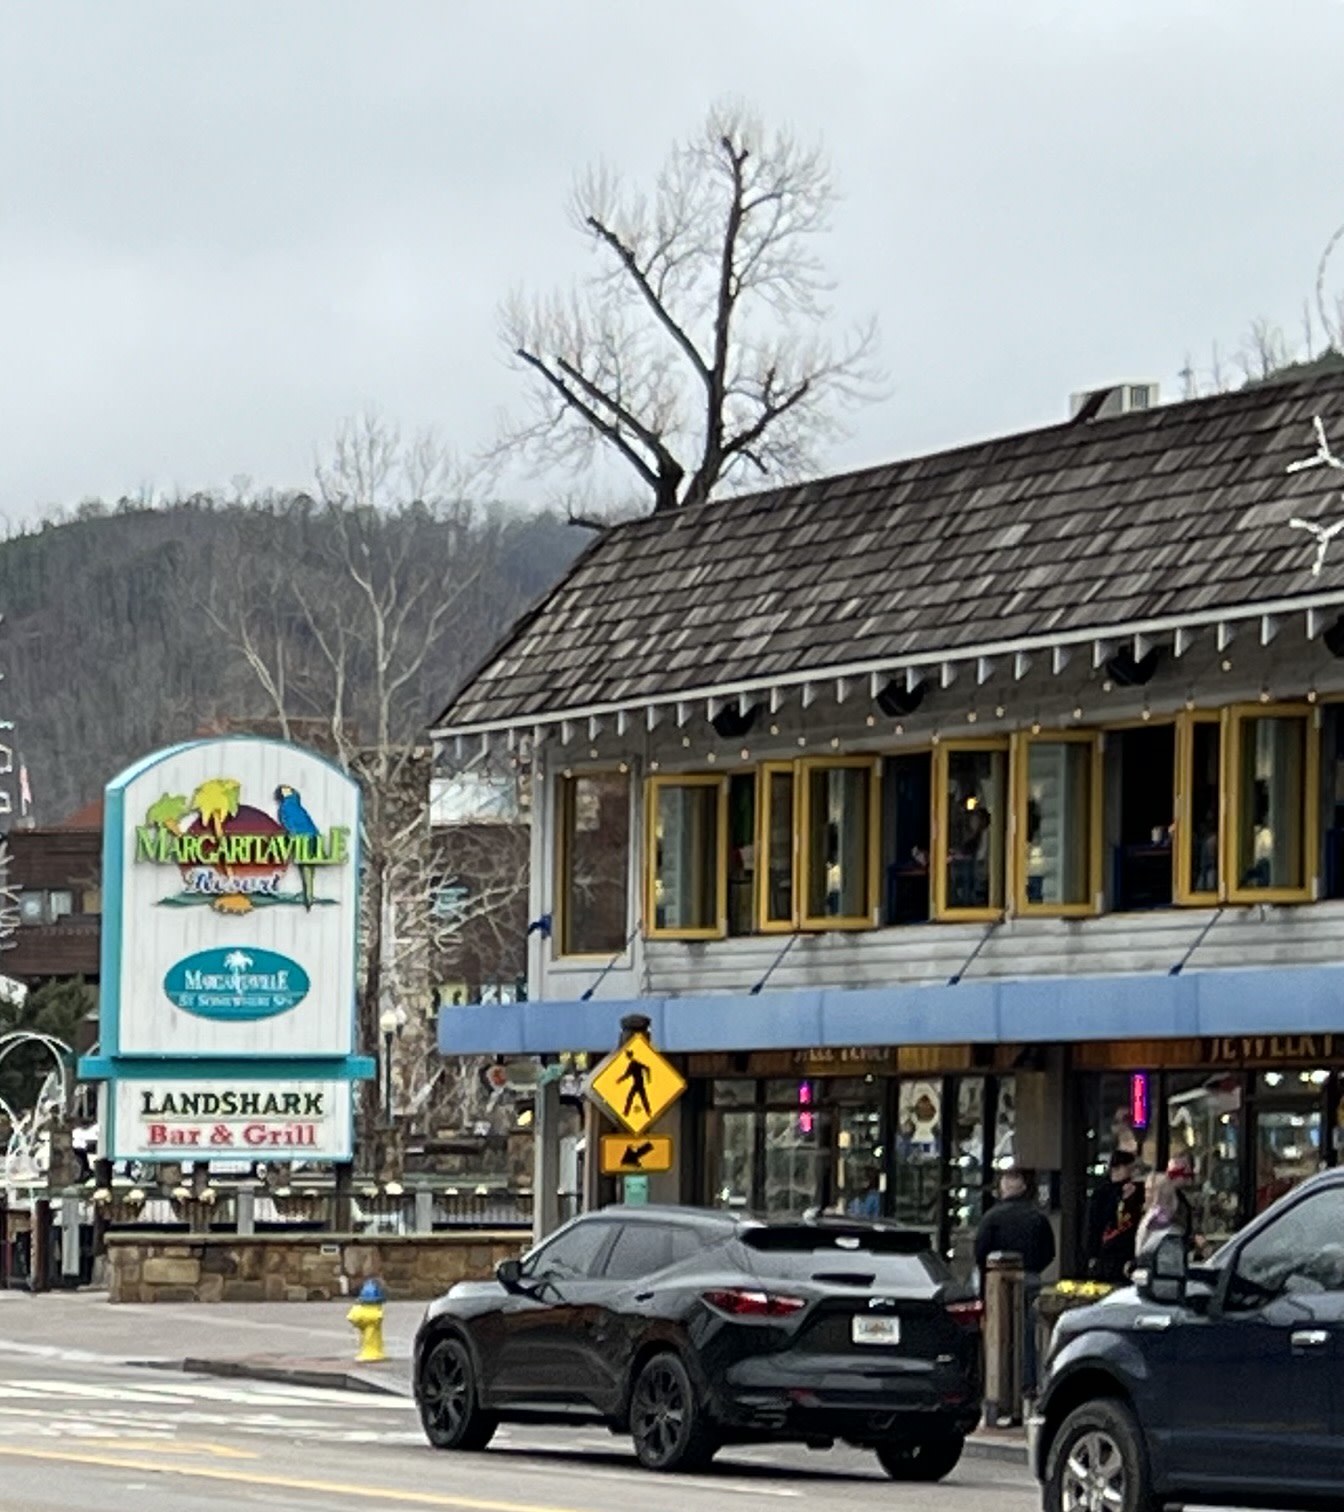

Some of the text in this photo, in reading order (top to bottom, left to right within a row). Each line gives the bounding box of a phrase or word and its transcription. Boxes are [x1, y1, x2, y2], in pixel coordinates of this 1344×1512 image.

[135, 825, 351, 865] MARGARITAVILLE
[186, 868, 282, 895] Resort
[140, 1091, 323, 1116] LANDSHARK
[147, 1123, 316, 1146] Bar & Grill
